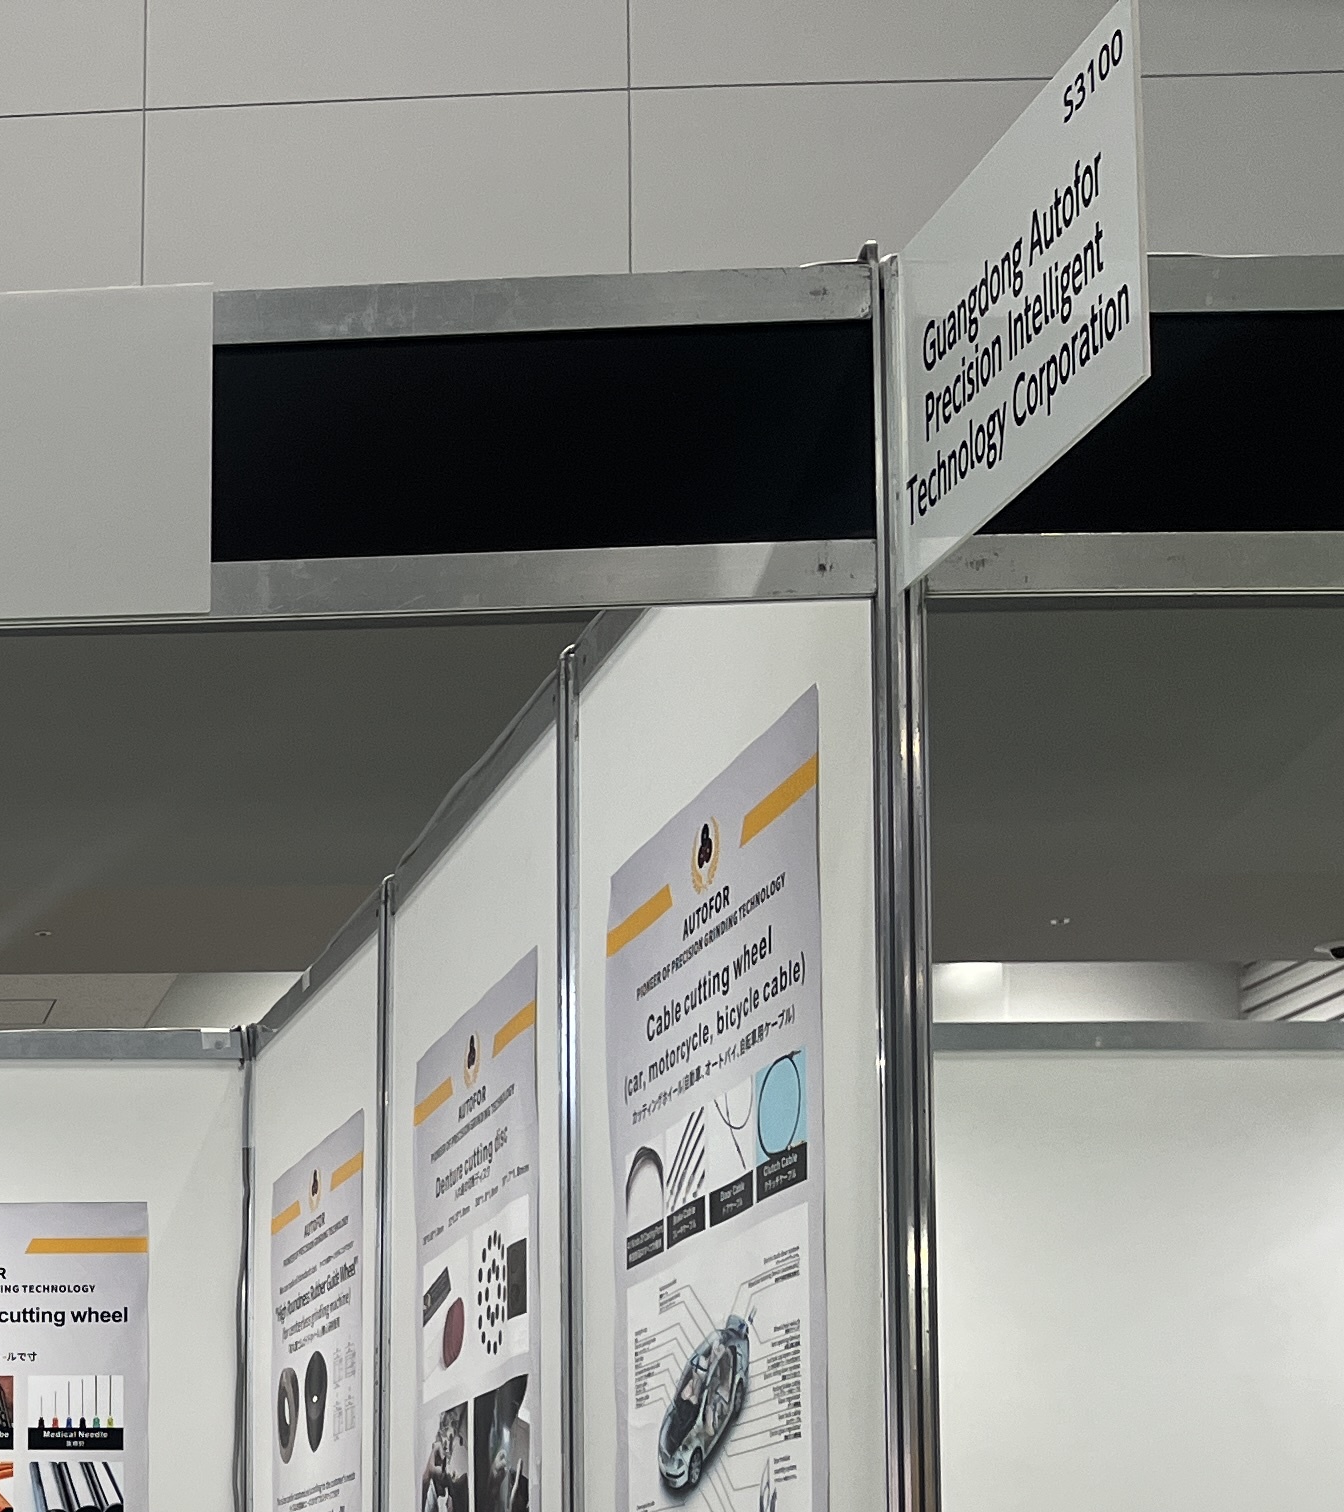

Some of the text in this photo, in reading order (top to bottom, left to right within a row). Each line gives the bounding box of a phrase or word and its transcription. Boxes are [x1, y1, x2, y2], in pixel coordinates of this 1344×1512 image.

[1063, 29, 1123, 123] S3100
[923, 151, 1102, 371] Guangdong Autofor
[926, 221, 1104, 442] Precision Intelligent
[906, 283, 1130, 525] Technology Corporation
[636, 872, 786, 1000] PIONEER OF PRECISION GRINDING TECHNOLOGY
[682, 885, 730, 941] AUTOFOR
[624, 951, 805, 1105] (car, motorcycle, bicycle cable)
[647, 924, 772, 1042] Cable cutting wheel
[458, 1085, 486, 1122] AUTOFOR
[436, 1163, 463, 1198] Denture
[464, 1141, 493, 1175] cutting
[22, 1284, 96, 1294] TECHNOLOGY
[71, 1306, 129, 1323] wheel
[43, 1430, 76, 1438] Medical
